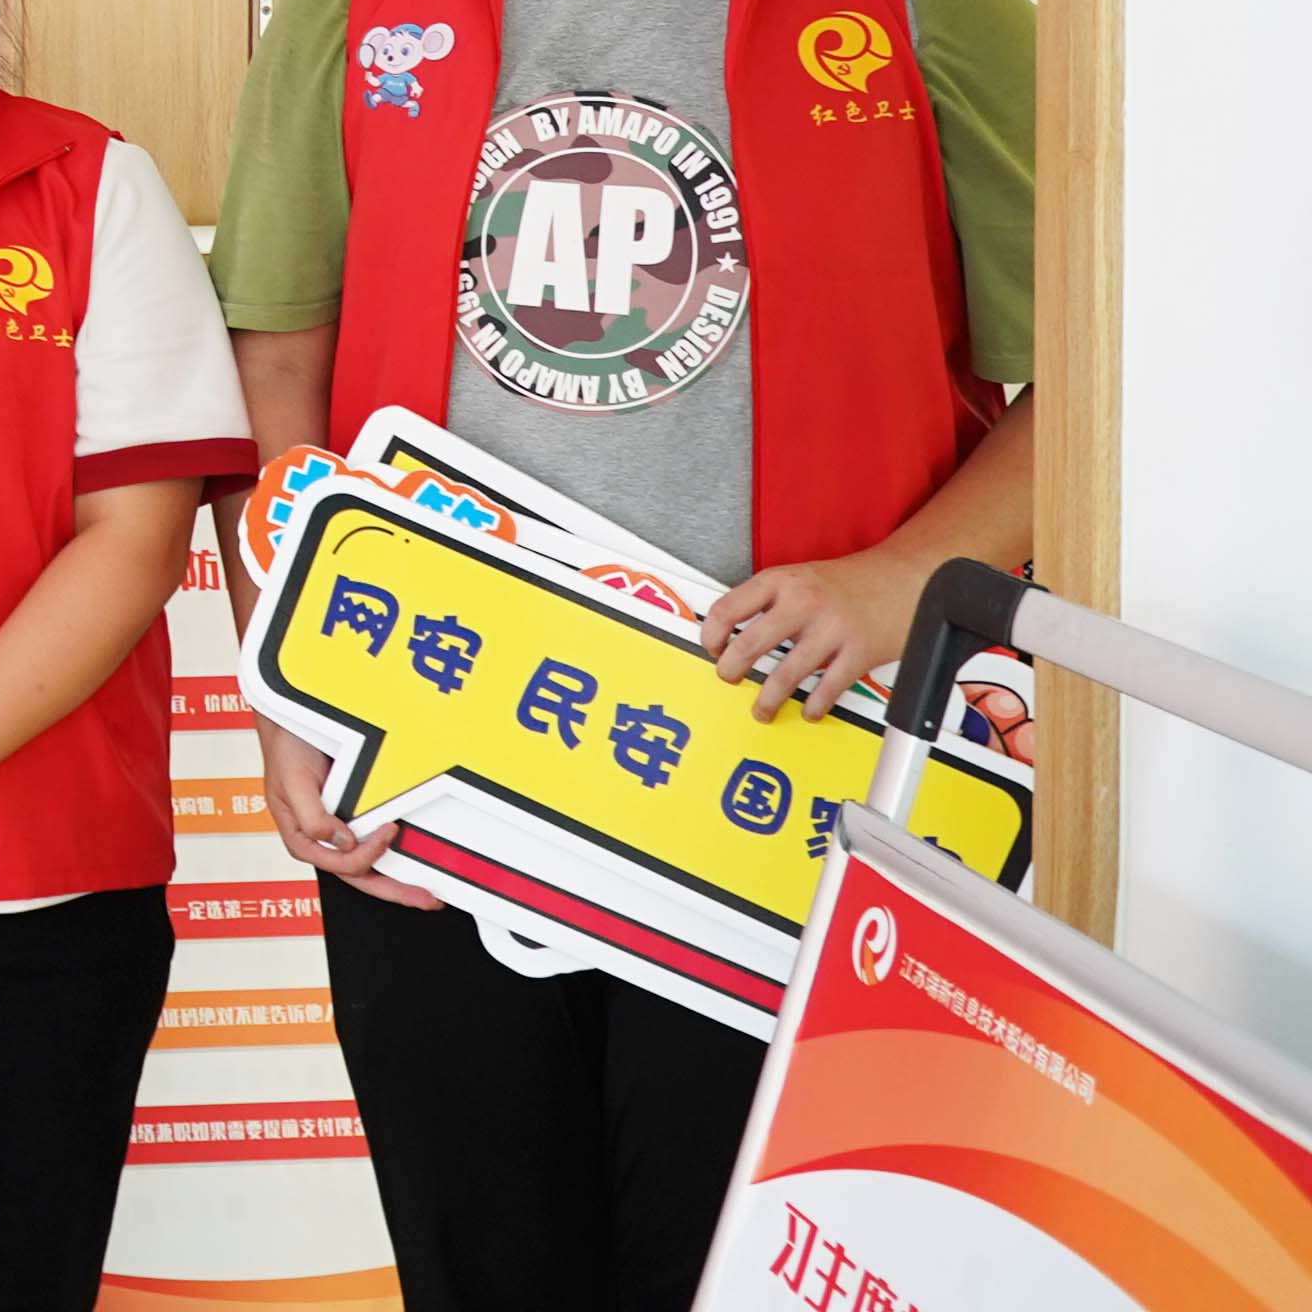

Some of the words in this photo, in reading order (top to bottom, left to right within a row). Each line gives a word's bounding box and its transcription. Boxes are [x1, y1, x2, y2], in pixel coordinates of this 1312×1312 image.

[810, 103, 917, 128] 红色卫士
[531, 107, 569, 142] BY
[578, 105, 681, 155] AMAPO
[671, 141, 713, 180] IN
[694, 172, 743, 244] 1991
[506, 179, 676, 317] AP
[470, 322, 509, 358] IN
[656, 284, 740, 383] DESIGN
[498, 348, 601, 404] AMAPO
[608, 367, 649, 405] BY
[321, 575, 484, 695] 网安
[516, 656, 692, 790] 民安
